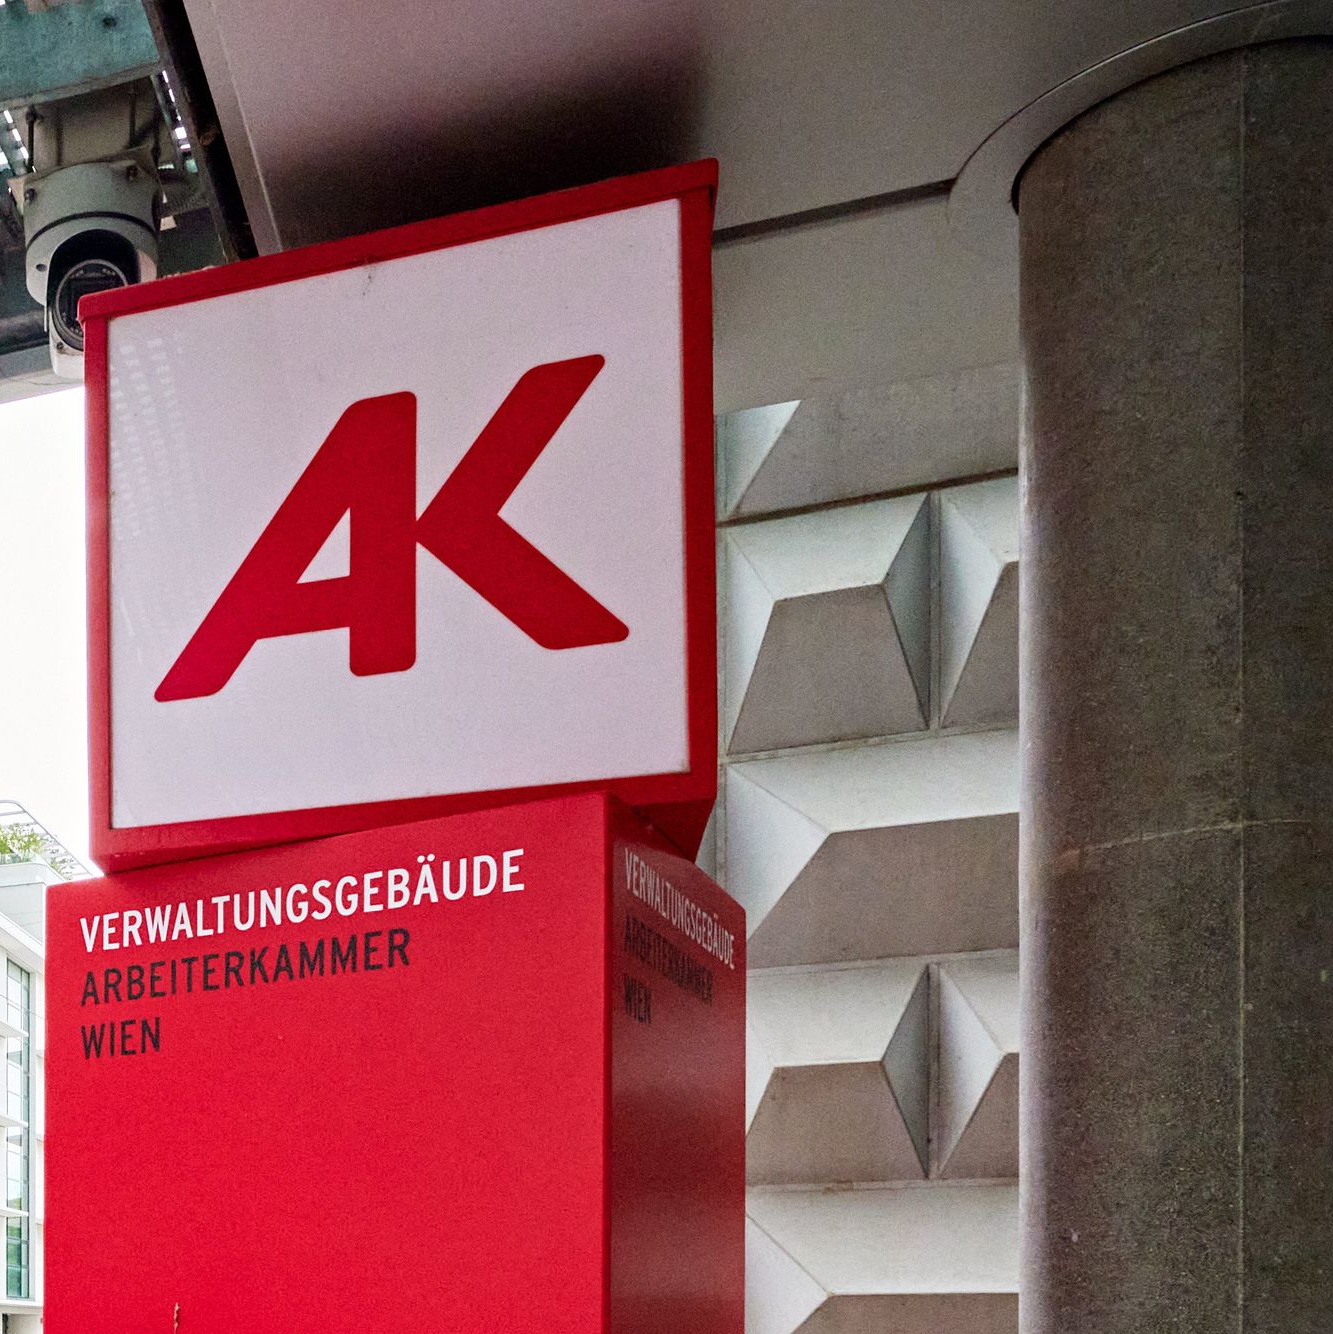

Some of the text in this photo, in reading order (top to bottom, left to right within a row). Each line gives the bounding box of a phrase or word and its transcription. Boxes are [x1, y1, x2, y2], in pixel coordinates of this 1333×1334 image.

[154, 354, 630, 703] AK
[79, 849, 525, 953] VERWALTUNGSGEBÄUDE
[624, 847, 736, 970] VERWALTUNGSGEBÄUDE
[80, 927, 411, 1007] ARBEITERKAMMER
[623, 973, 652, 1025] WIEN
[80, 1016, 161, 1060] WIEN
